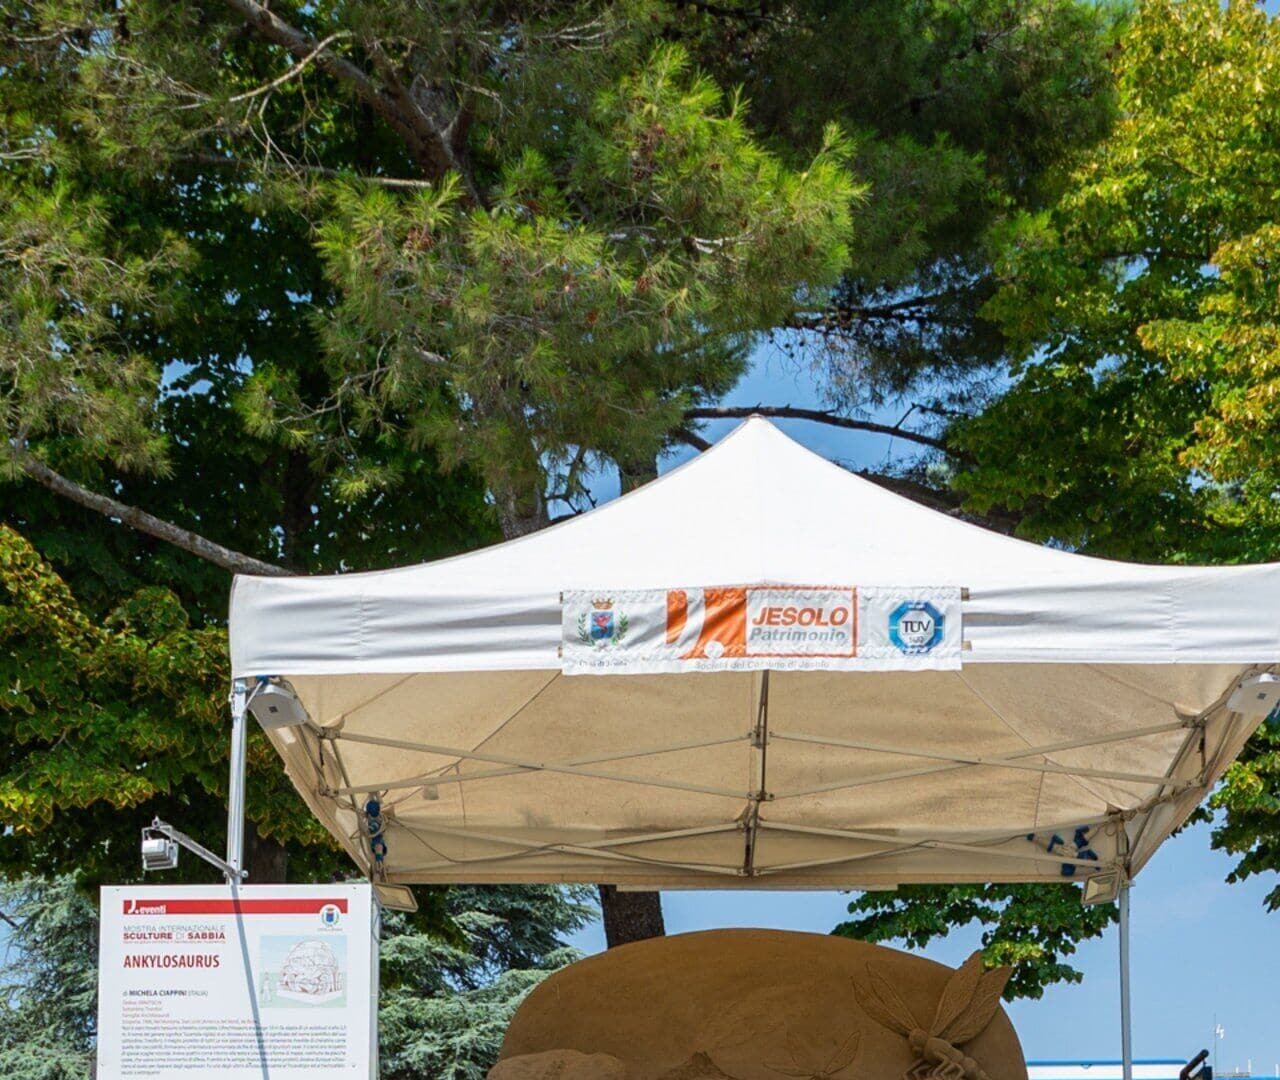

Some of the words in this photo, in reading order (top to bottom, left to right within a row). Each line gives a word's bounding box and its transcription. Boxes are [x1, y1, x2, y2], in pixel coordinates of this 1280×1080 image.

[752, 607, 849, 627] JESOLO
[750, 627, 846, 642] Patrimonio
[731, 661, 745, 670] del
[123, 932, 173, 940] SCULTURE
[176, 932, 185, 940] DI
[188, 932, 226, 940] SABBIA
[123, 954, 220, 968] ANKYLOSAURUS
